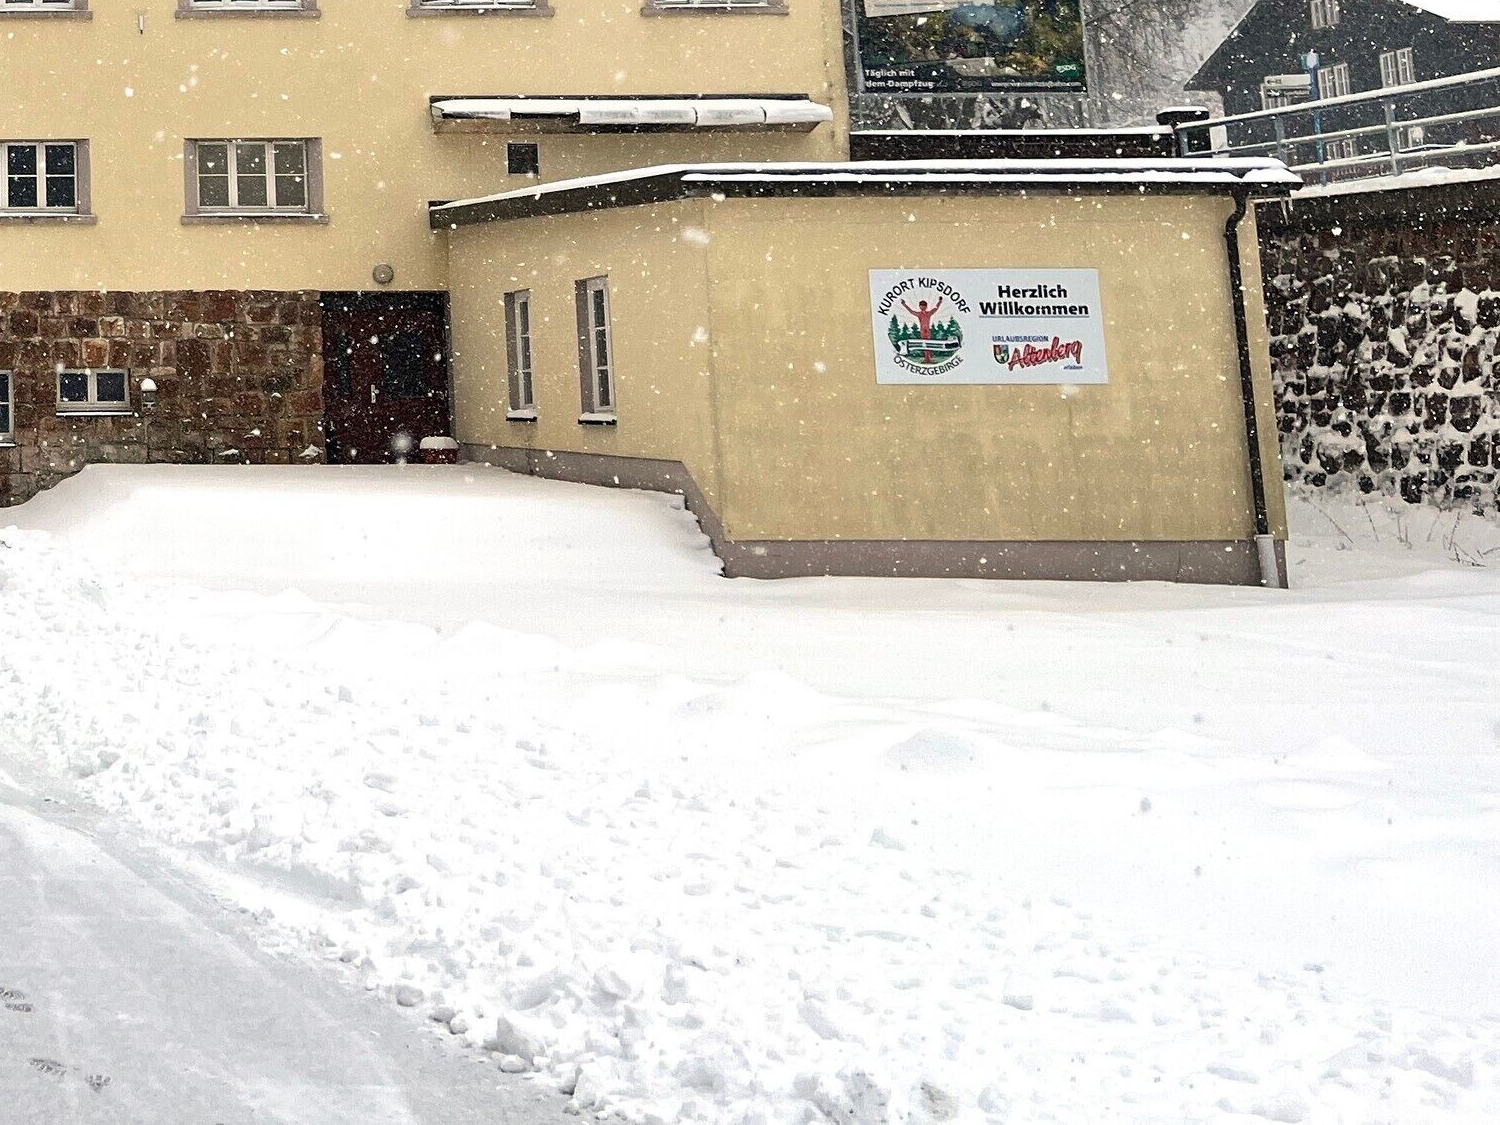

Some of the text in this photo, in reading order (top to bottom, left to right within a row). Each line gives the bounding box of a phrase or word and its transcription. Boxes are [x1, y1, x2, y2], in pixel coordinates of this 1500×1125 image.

[865, 69, 897, 78] Täglich
[888, 80, 934, 88] Dampfzug
[877, 277, 971, 316] KURORT KIPSDORF
[998, 285, 1068, 299] Herzlich
[979, 301, 1090, 315] Willkommen
[1007, 336, 1083, 371] Altenberg
[893, 355, 964, 376] OSTERZGEBIRGE
